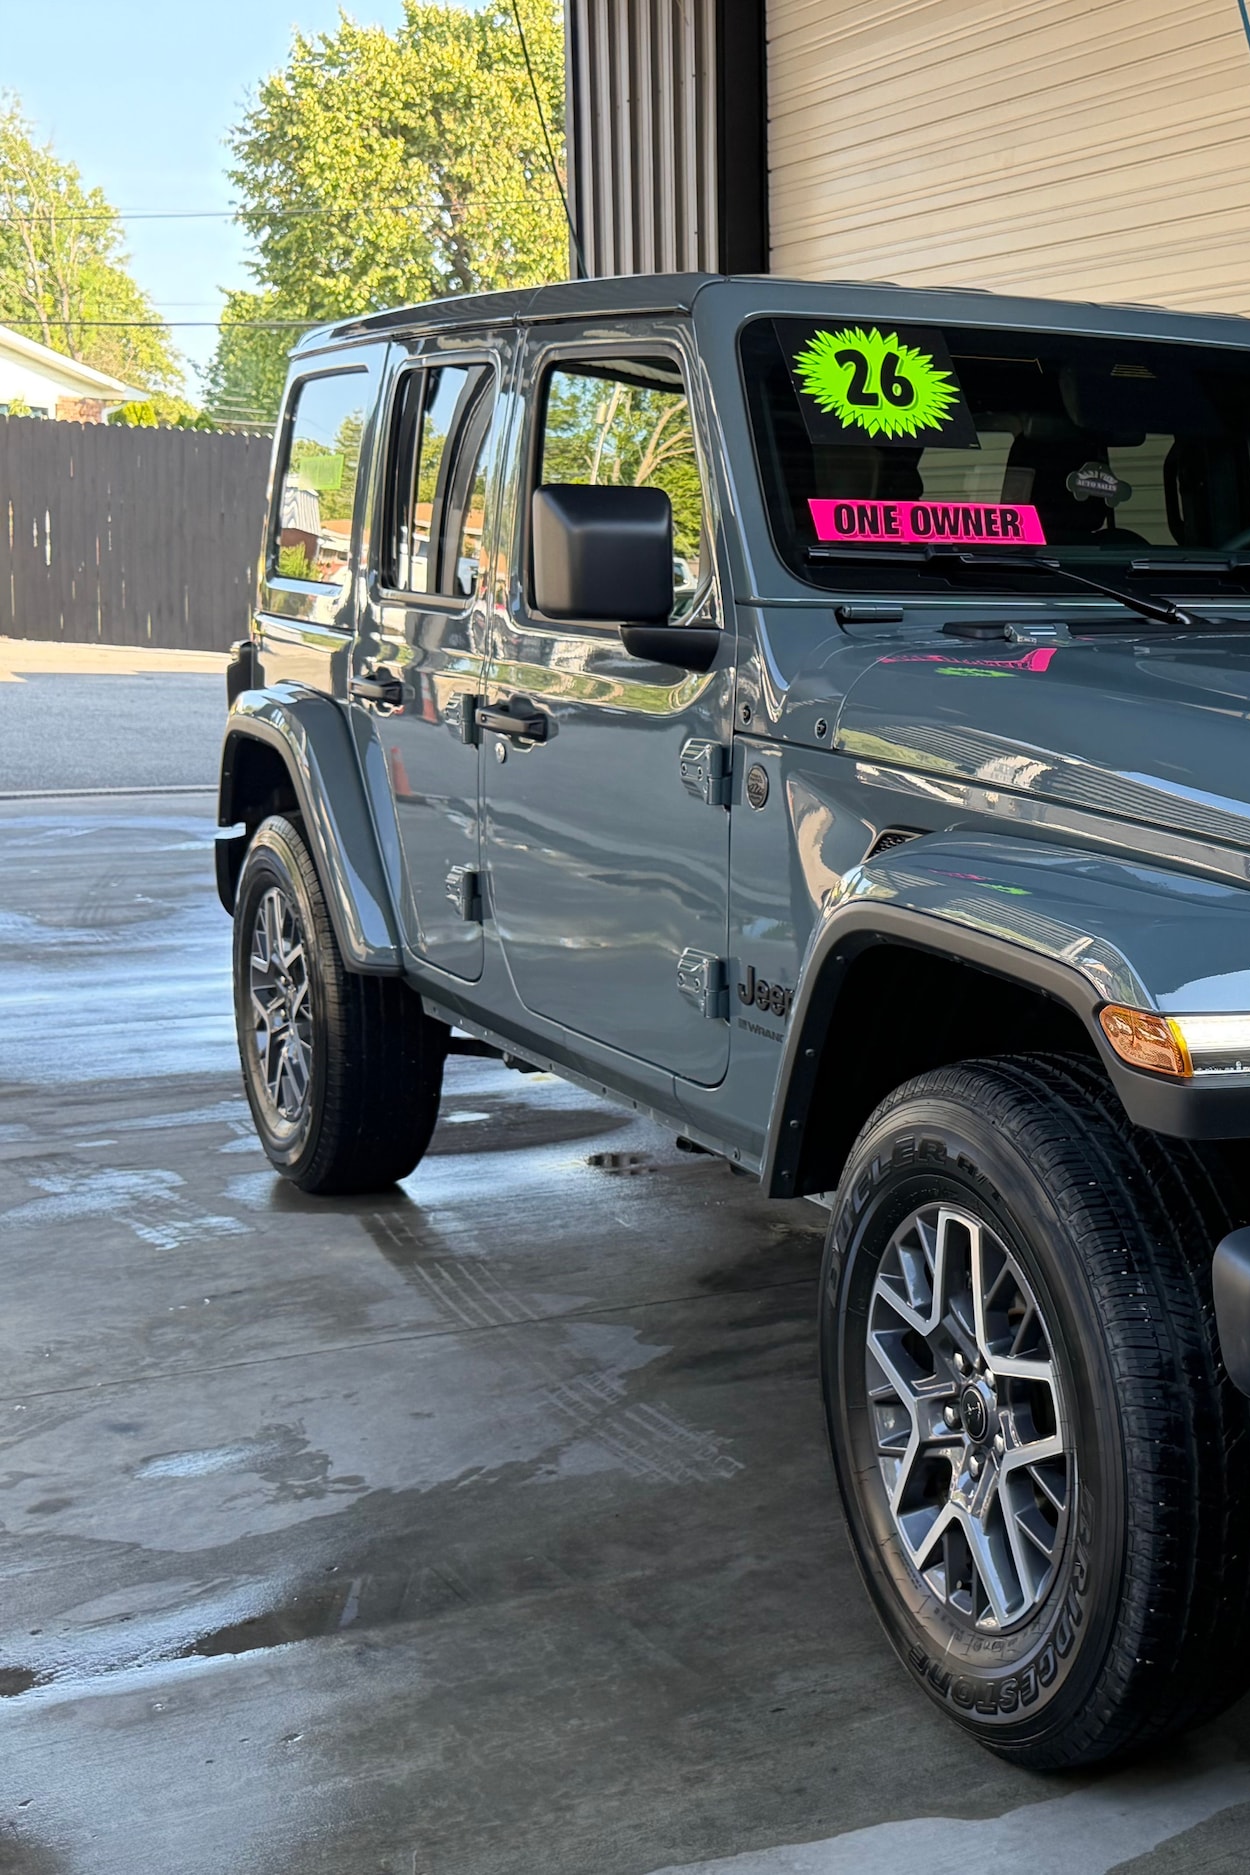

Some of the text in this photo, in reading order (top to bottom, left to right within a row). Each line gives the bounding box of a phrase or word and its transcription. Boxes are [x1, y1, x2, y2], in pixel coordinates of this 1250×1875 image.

[834, 349, 916, 409] 26
[1076, 479, 1097, 488] AUTO
[834, 503, 1021, 539] ONE OWNER
[908, 1478, 1095, 1715] BRIDGESTONE
